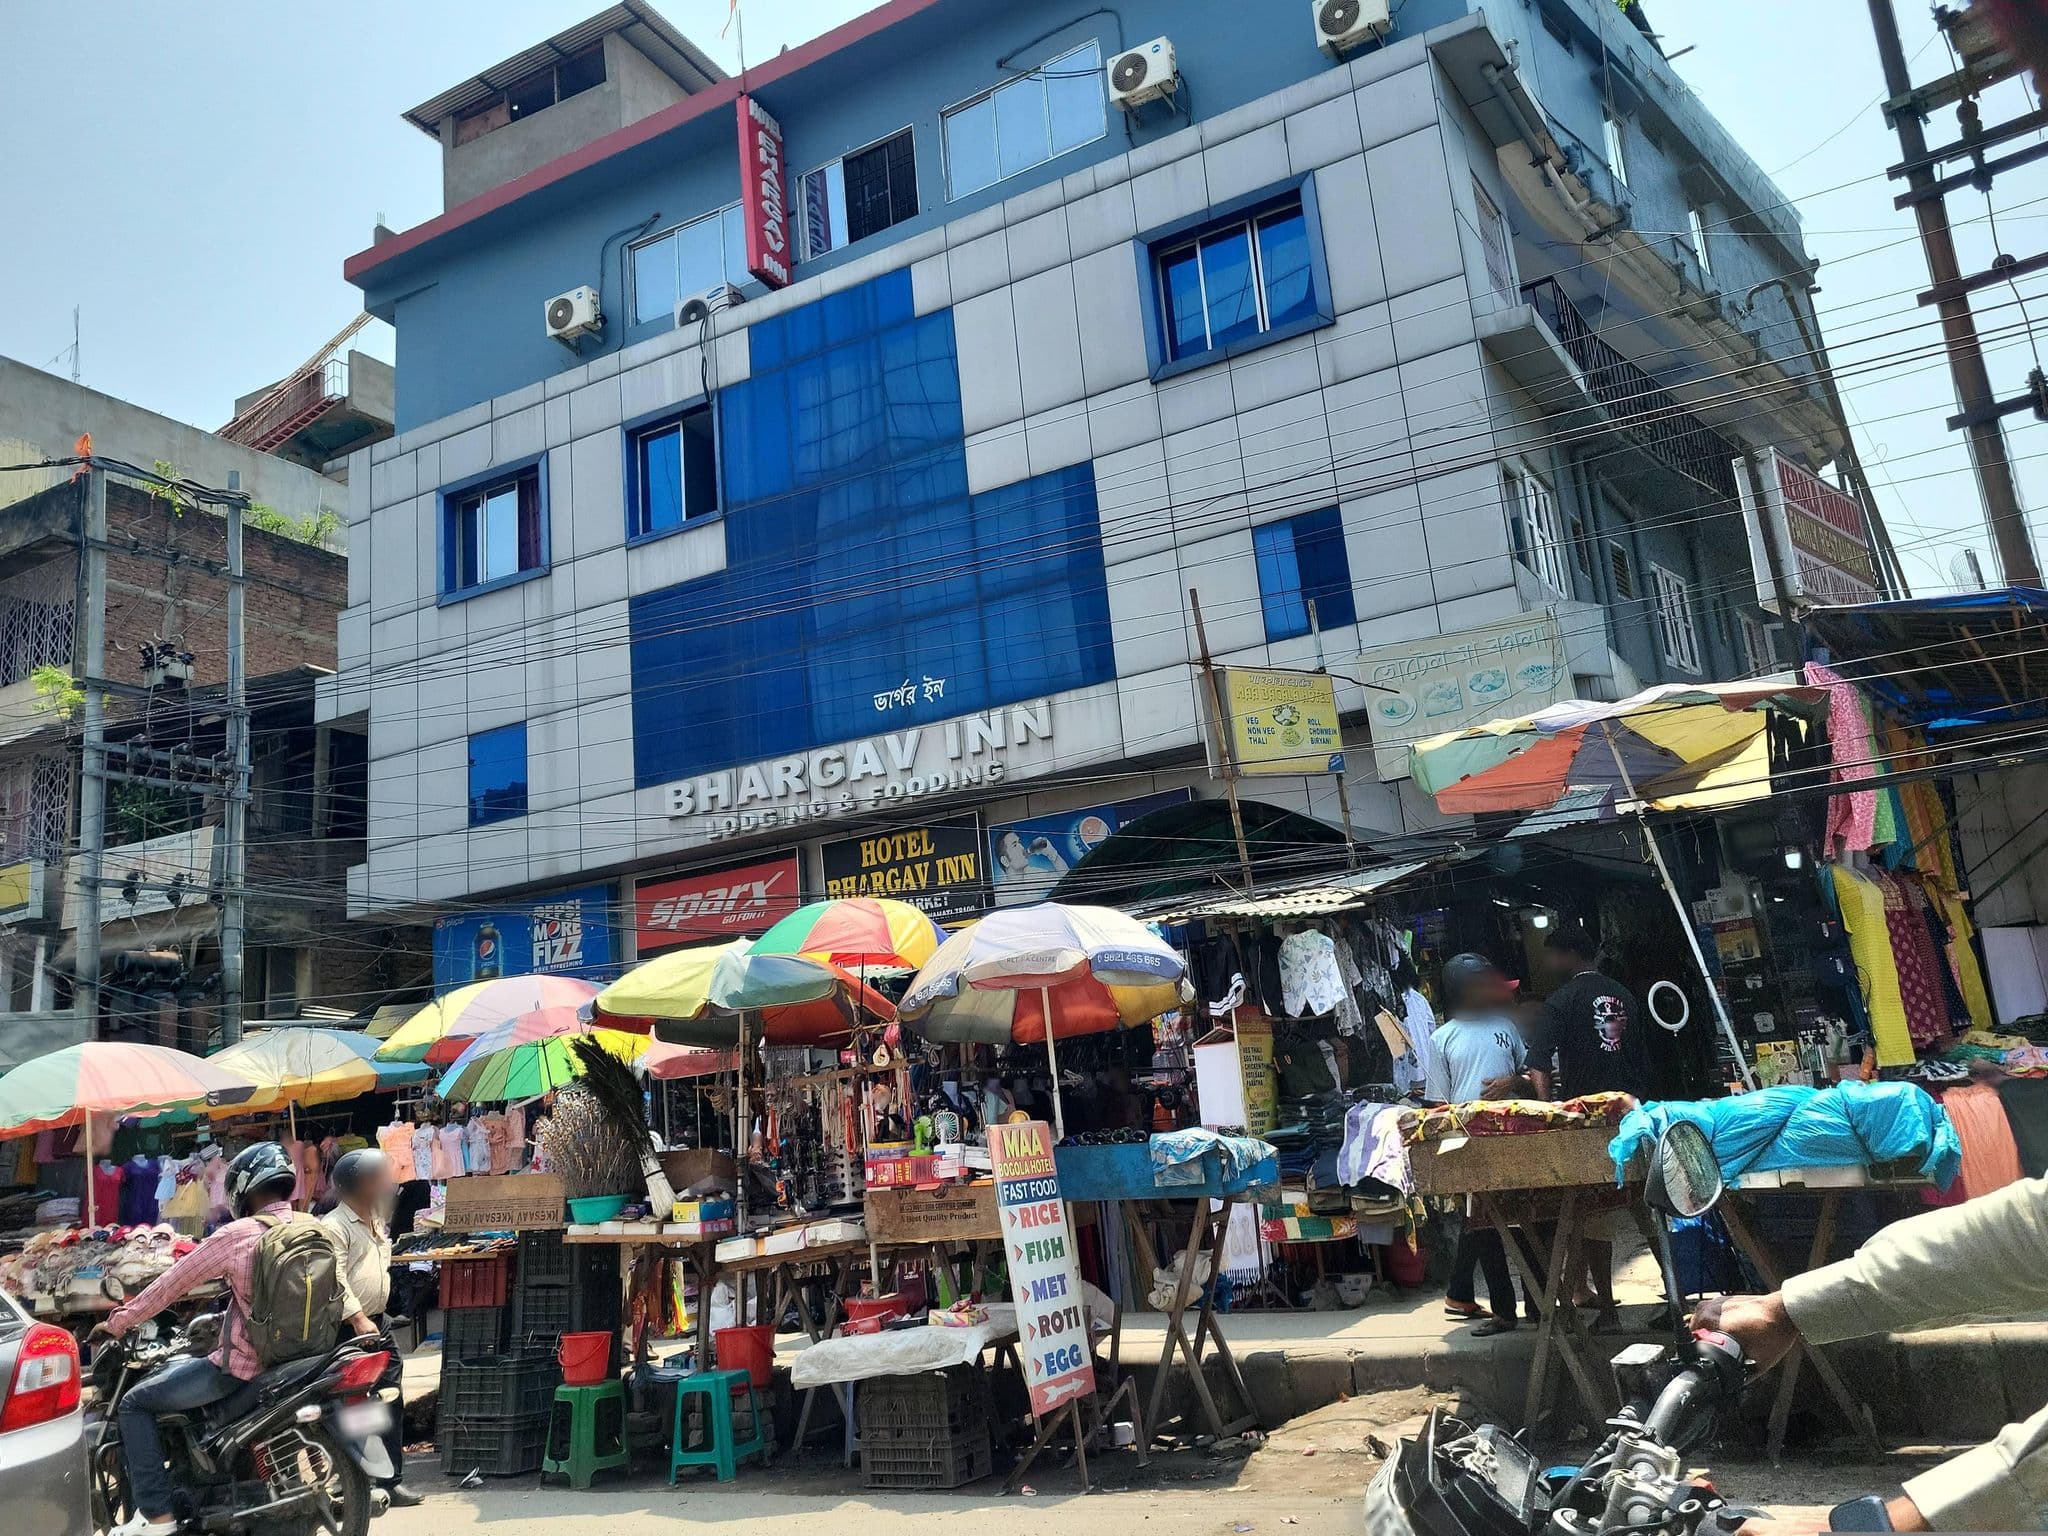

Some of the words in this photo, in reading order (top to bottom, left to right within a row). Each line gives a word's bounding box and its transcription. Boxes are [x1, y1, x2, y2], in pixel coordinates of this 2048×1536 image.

[750, 98, 782, 142] HOTEL
[758, 130, 784, 253] BHARGAV
[763, 253, 787, 284] INN
[922, 675, 945, 702] ইন
[1246, 717, 1259, 725] VEG
[1247, 727, 1262, 735] NON
[1307, 718, 1321, 726] ROLL
[1249, 737, 1268, 745] THALI
[1310, 737, 1332, 745] BIRYANI
[664, 730, 922, 820] BHARGAV
[945, 698, 1053, 760] INN
[706, 796, 829, 840] LODGING
[841, 791, 858, 813] &
[871, 760, 1005, 807] FOODING
[860, 828, 935, 868] HOTEL
[827, 861, 930, 899] BHARGAV
[935, 852, 976, 887] INN
[646, 870, 785, 930] sparx
[722, 914, 736, 925] GO
[532, 934, 583, 967] FIZZ
[1002, 1127, 1045, 1159] MAA
[999, 1160, 1031, 1179] BOGOLA
[1031, 1158, 1054, 1174] HOTEL
[1003, 1182, 1030, 1202] FAST
[1030, 1177, 1057, 1198] FOOD
[923, 1213, 949, 1223] Quality
[949, 1211, 978, 1220] Product
[1018, 1202, 1061, 1229] RICE
[1025, 1236, 1066, 1265] FISH
[1031, 1272, 1067, 1303] MET
[1038, 1305, 1081, 1339] ROTI
[1044, 1343, 1083, 1377] EGG
